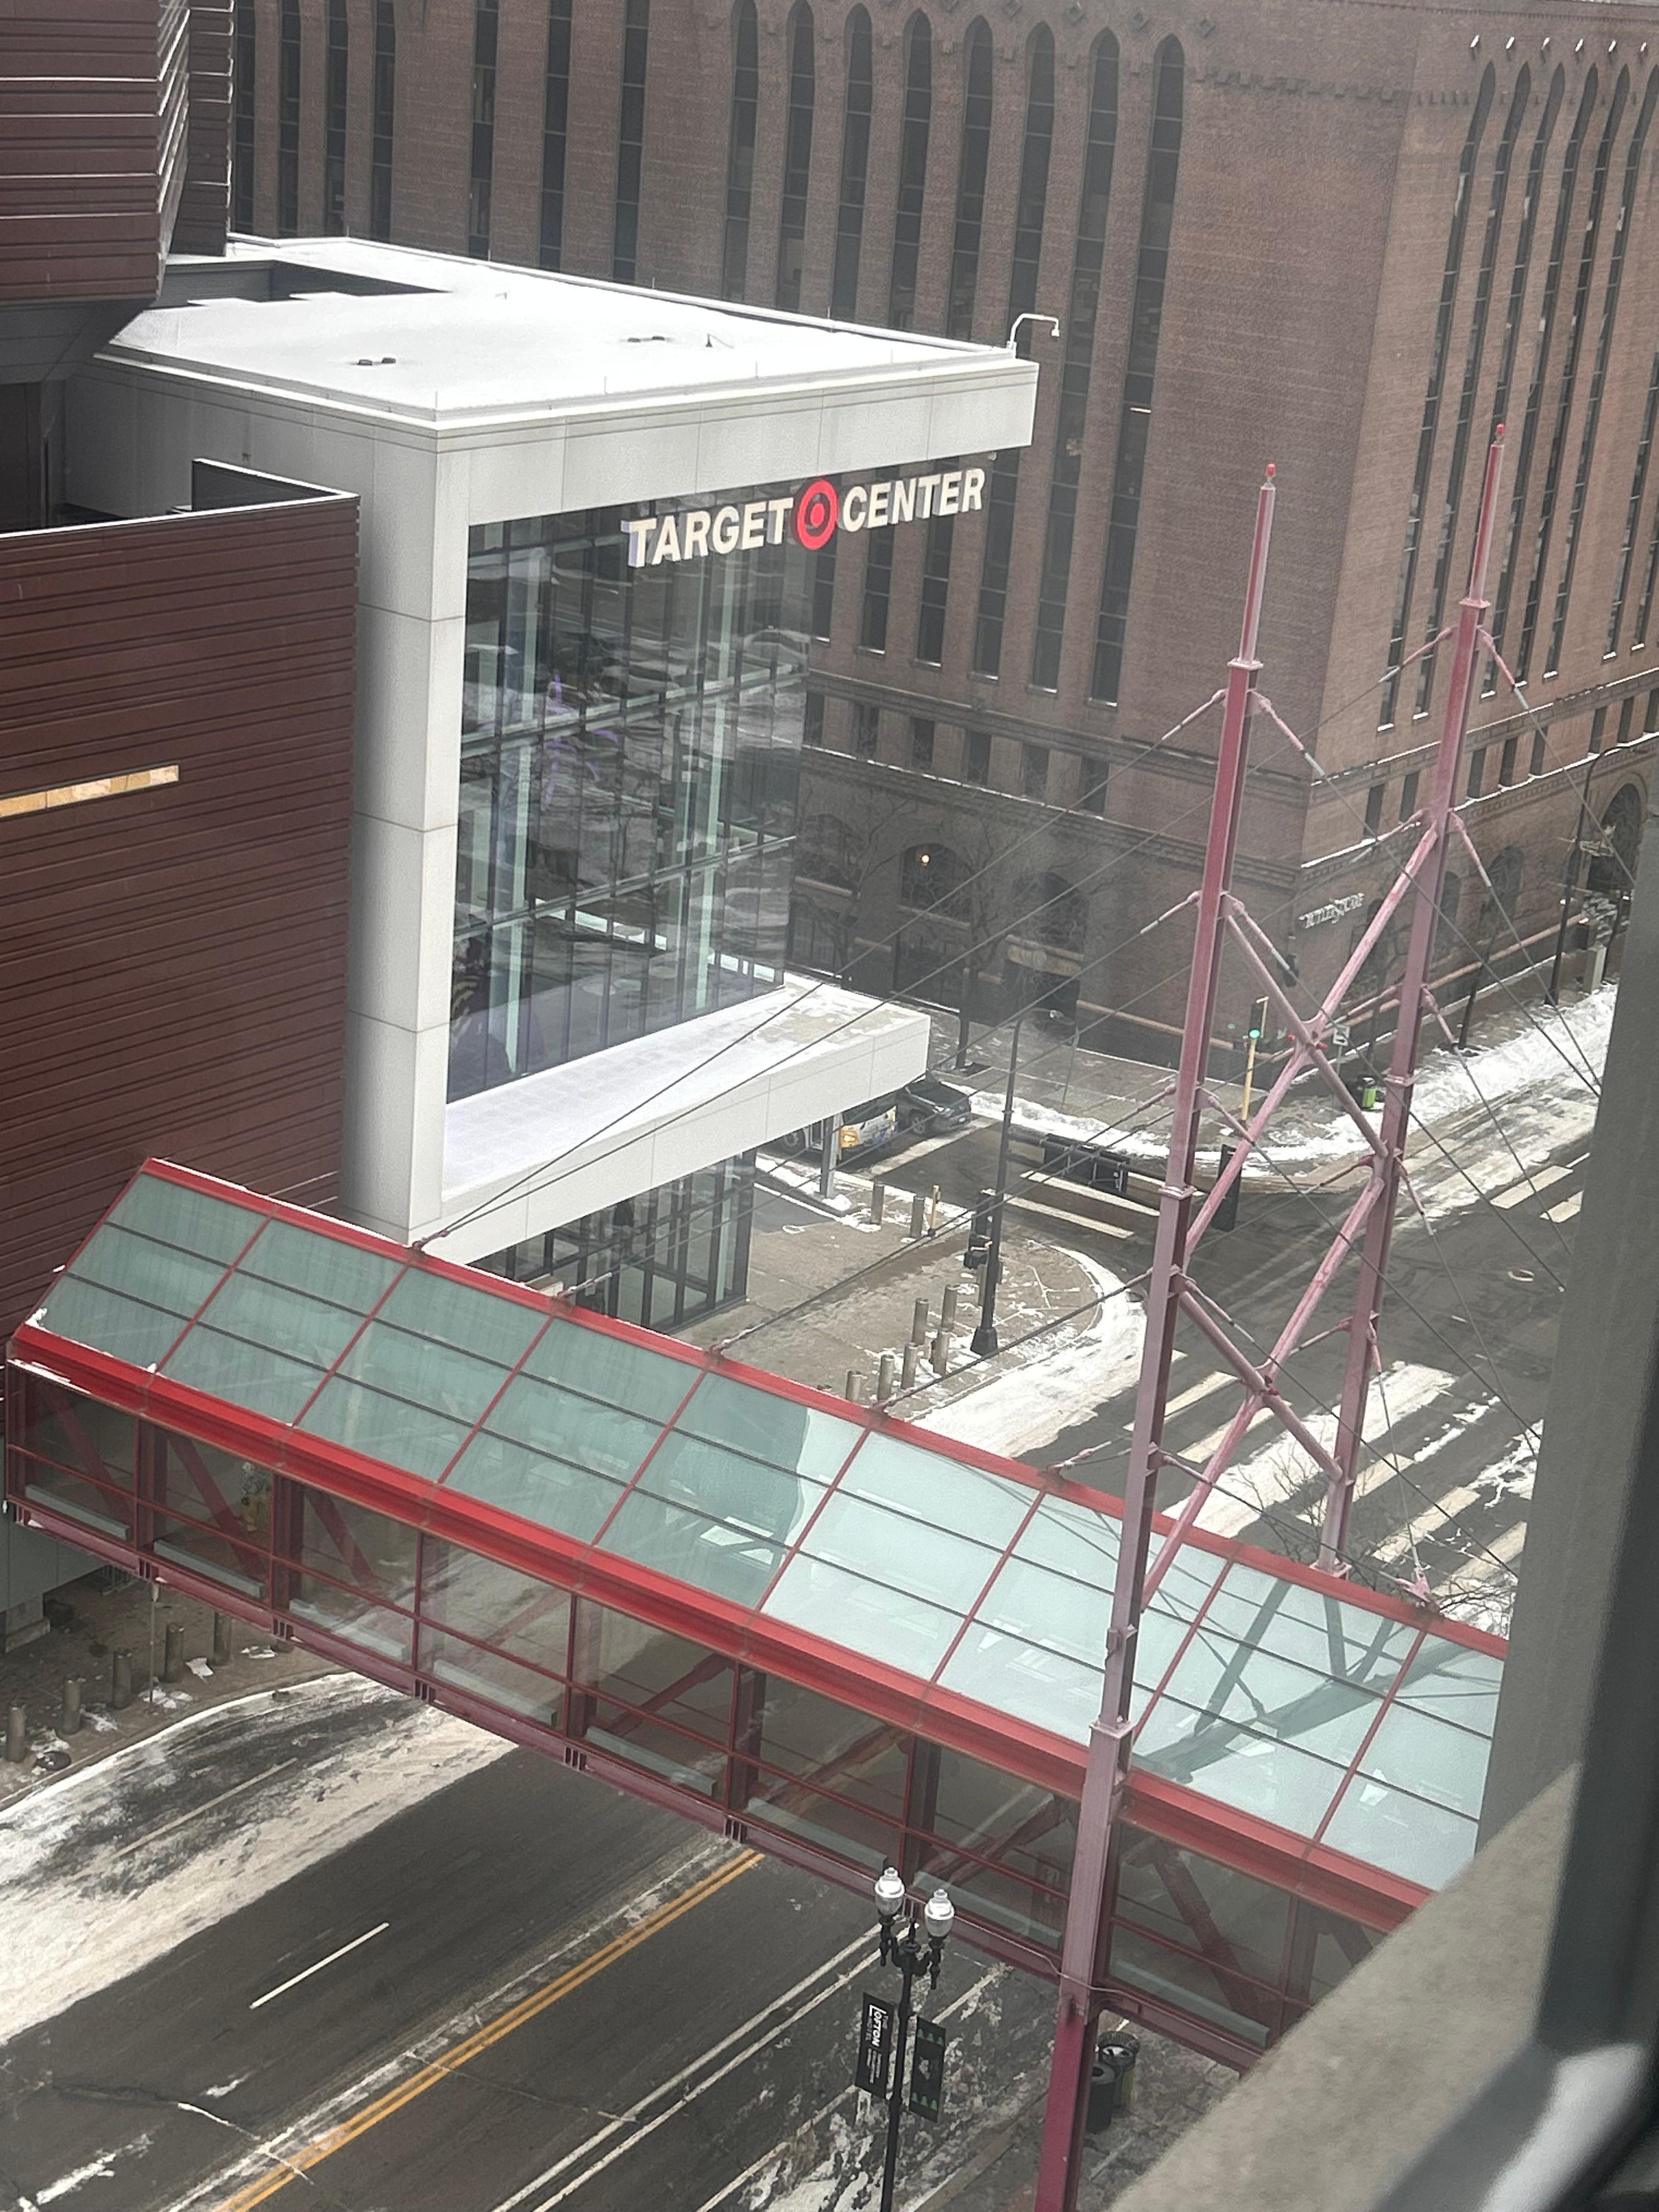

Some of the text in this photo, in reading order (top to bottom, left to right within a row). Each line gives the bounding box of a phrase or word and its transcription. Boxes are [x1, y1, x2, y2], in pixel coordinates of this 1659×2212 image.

[621, 469, 985, 567] TARGET CENTER
[869, 2005, 887, 2047] LOFTON
